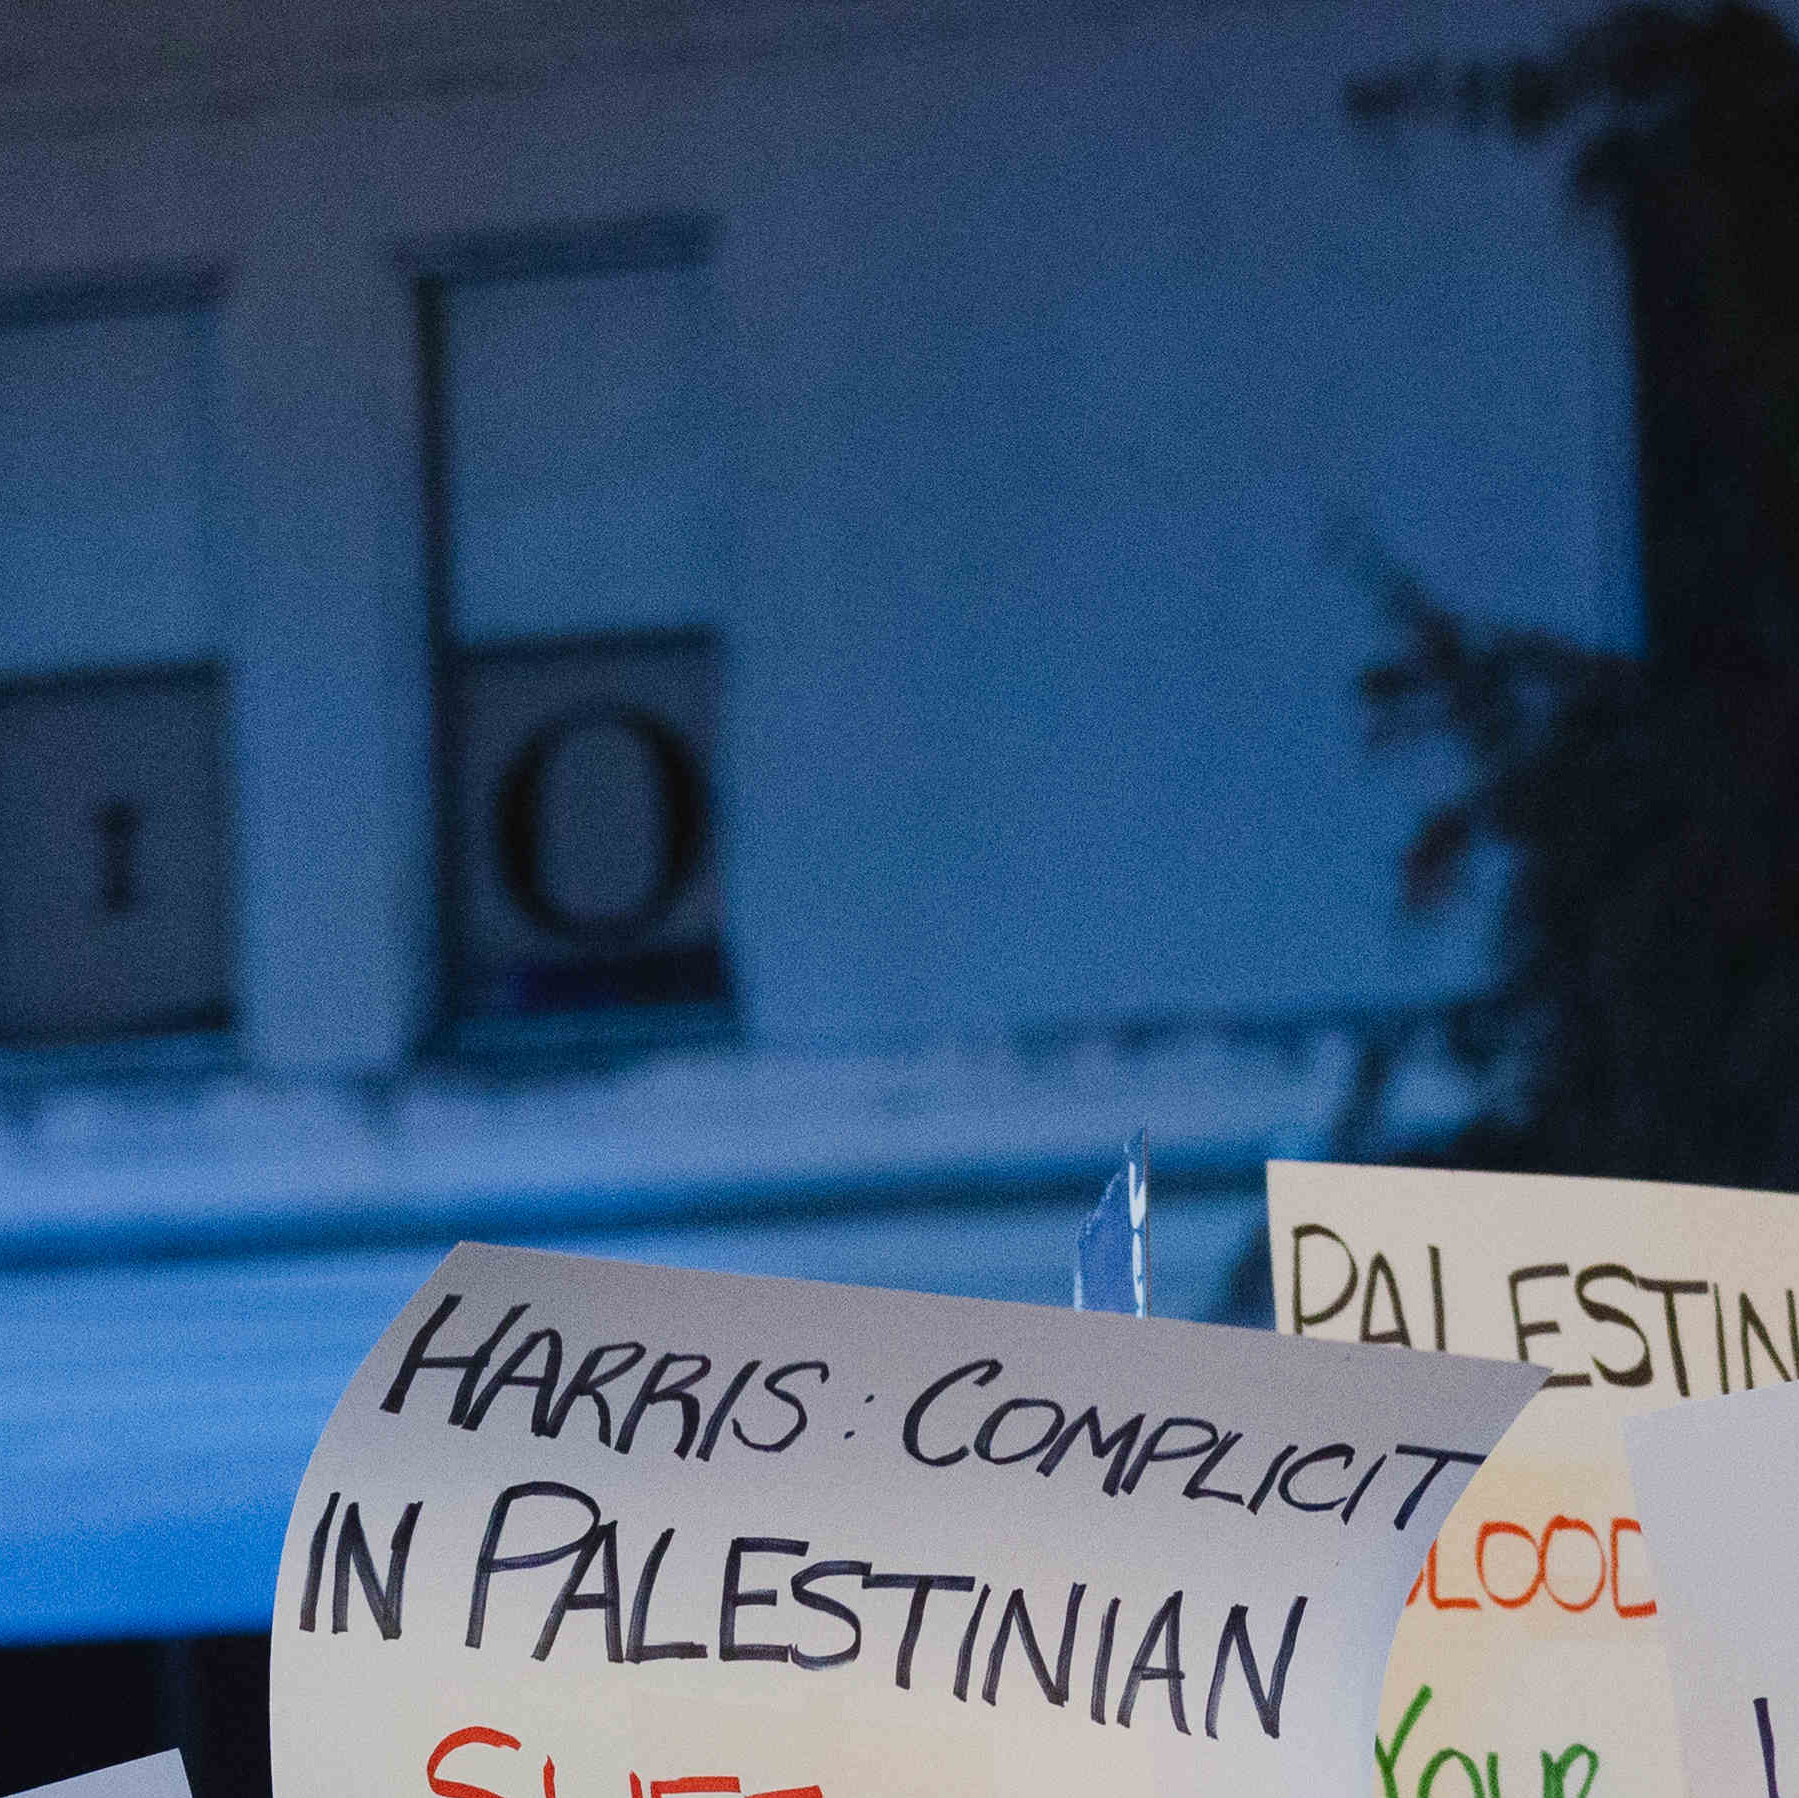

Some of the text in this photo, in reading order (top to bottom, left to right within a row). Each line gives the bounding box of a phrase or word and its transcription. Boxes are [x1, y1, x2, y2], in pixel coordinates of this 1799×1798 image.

[902, 1358, 1488, 1531] COMPLICIT
[298, 1480, 1308, 1741] IN PALESTINIAN
